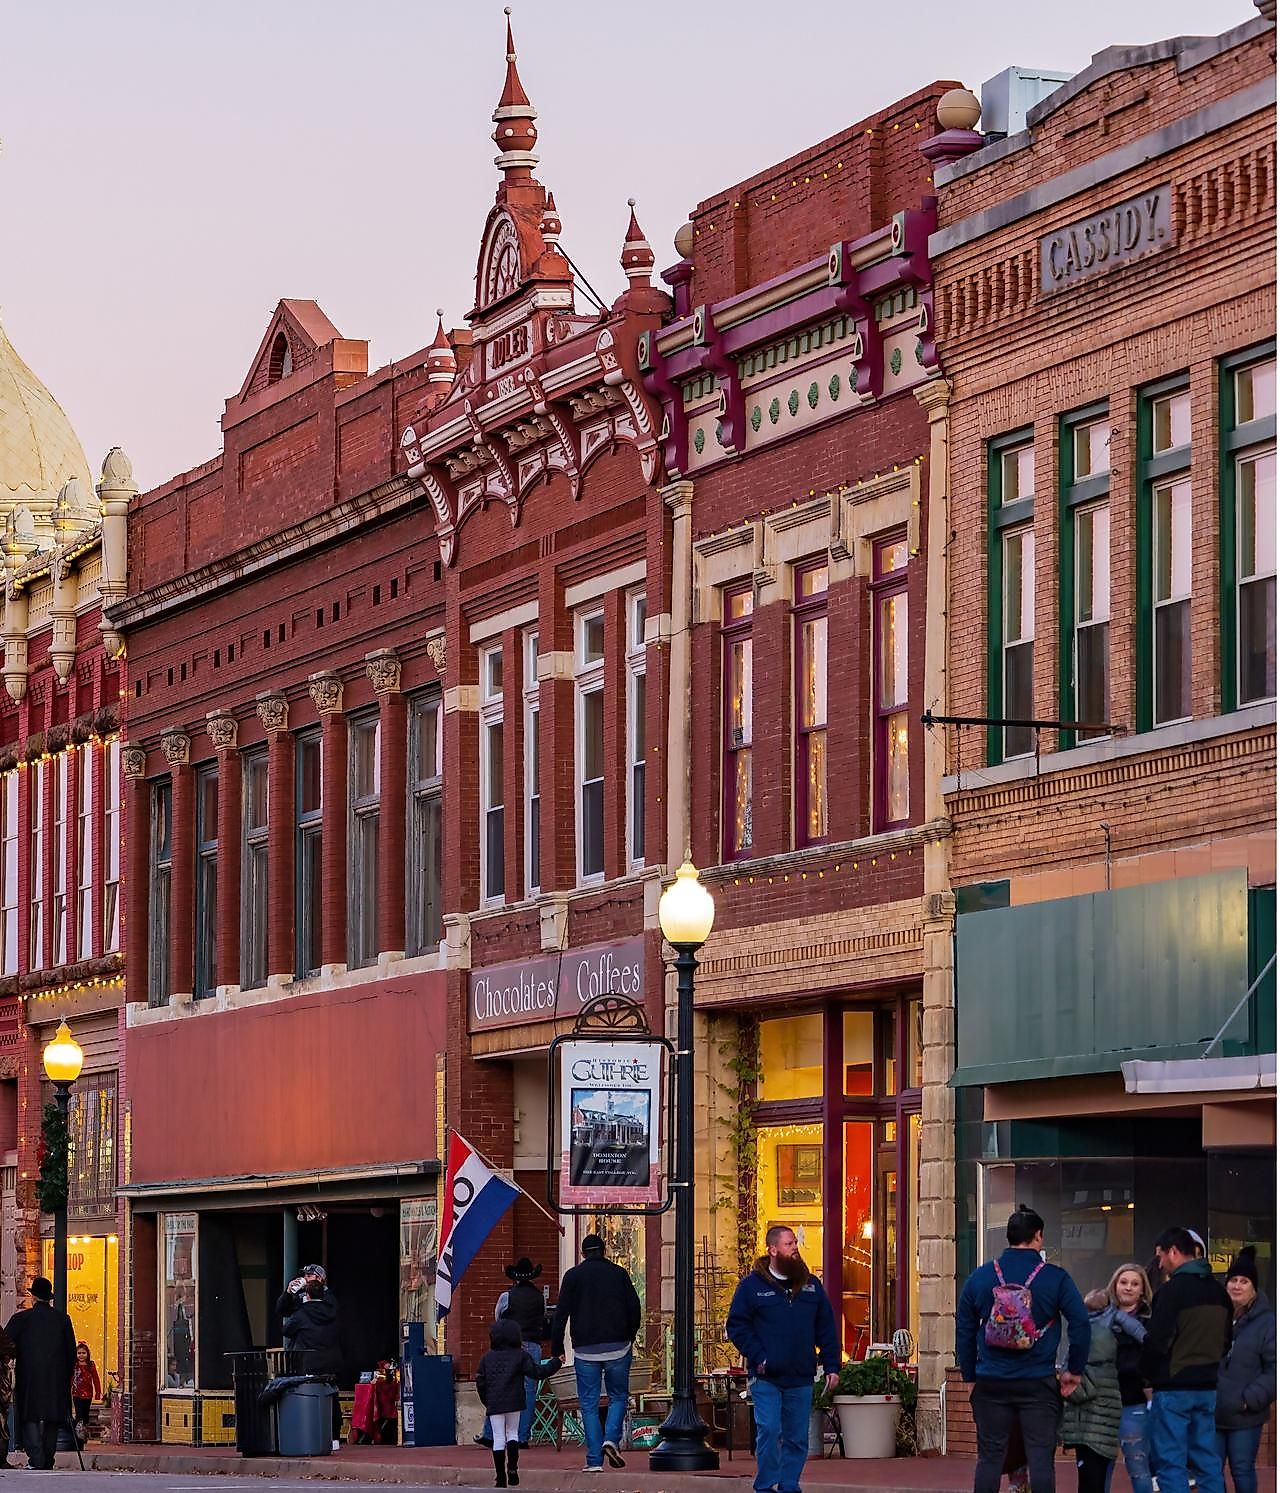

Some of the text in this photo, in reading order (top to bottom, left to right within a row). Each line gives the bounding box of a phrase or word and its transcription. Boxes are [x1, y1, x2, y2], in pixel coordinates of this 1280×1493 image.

[474, 952, 641, 1020] Chocolates Coffees
[571, 1059, 650, 1084] GUTHRIE
